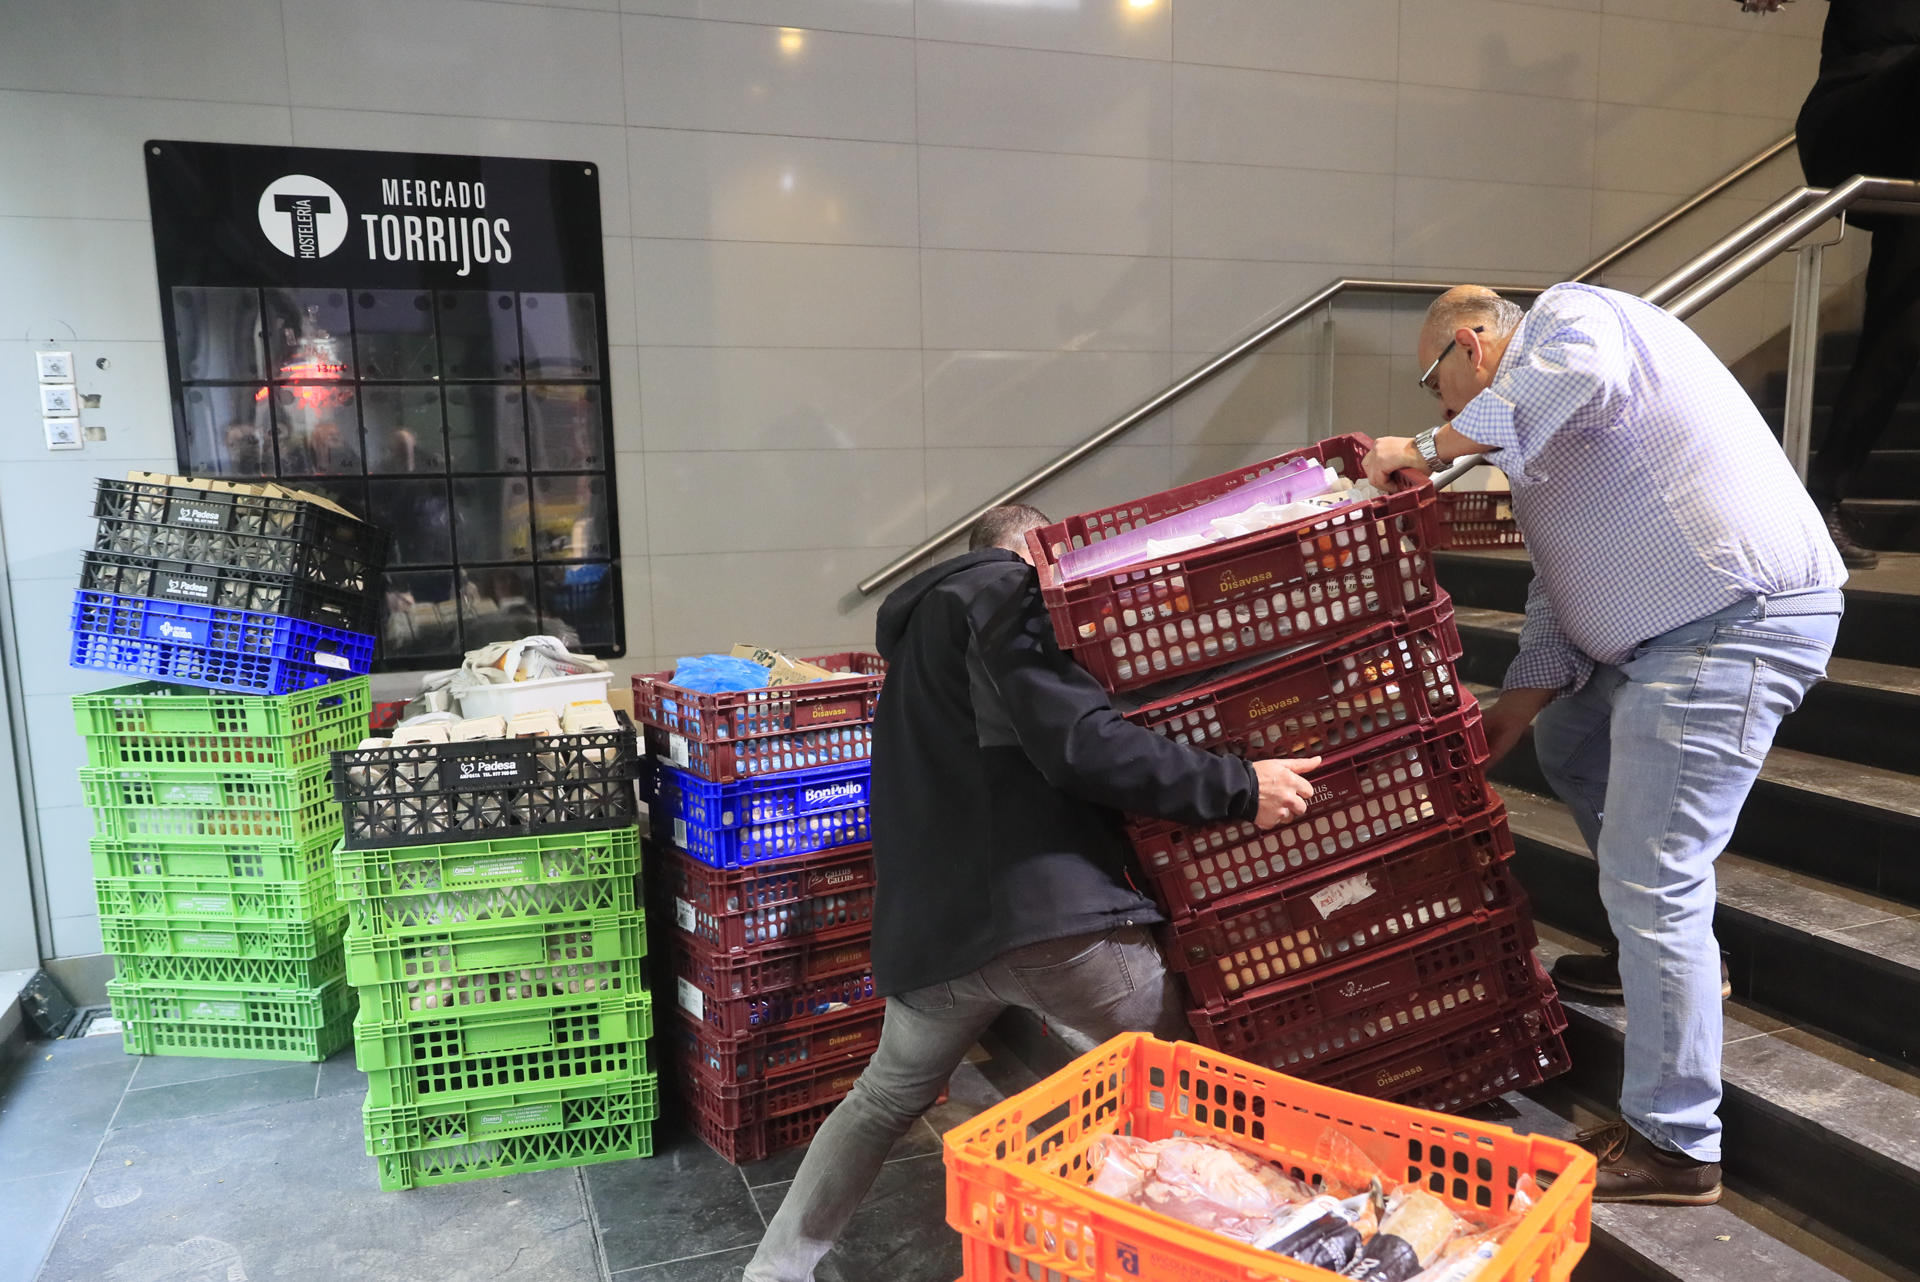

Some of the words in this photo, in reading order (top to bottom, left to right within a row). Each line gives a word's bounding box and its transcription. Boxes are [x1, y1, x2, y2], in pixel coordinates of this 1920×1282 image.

[381, 178, 486, 209] MERCADO
[293, 199, 316, 259] HOSTELERÍA
[360, 213, 512, 276] TORRIJOS
[191, 508, 220, 520] Padesa
[1219, 570, 1273, 593] Disavasa
[812, 708, 847, 719] Disavasa
[1249, 695, 1301, 719] Disavasa
[478, 760, 517, 773] Padesa
[1377, 1065, 1423, 1087] Disavasa
